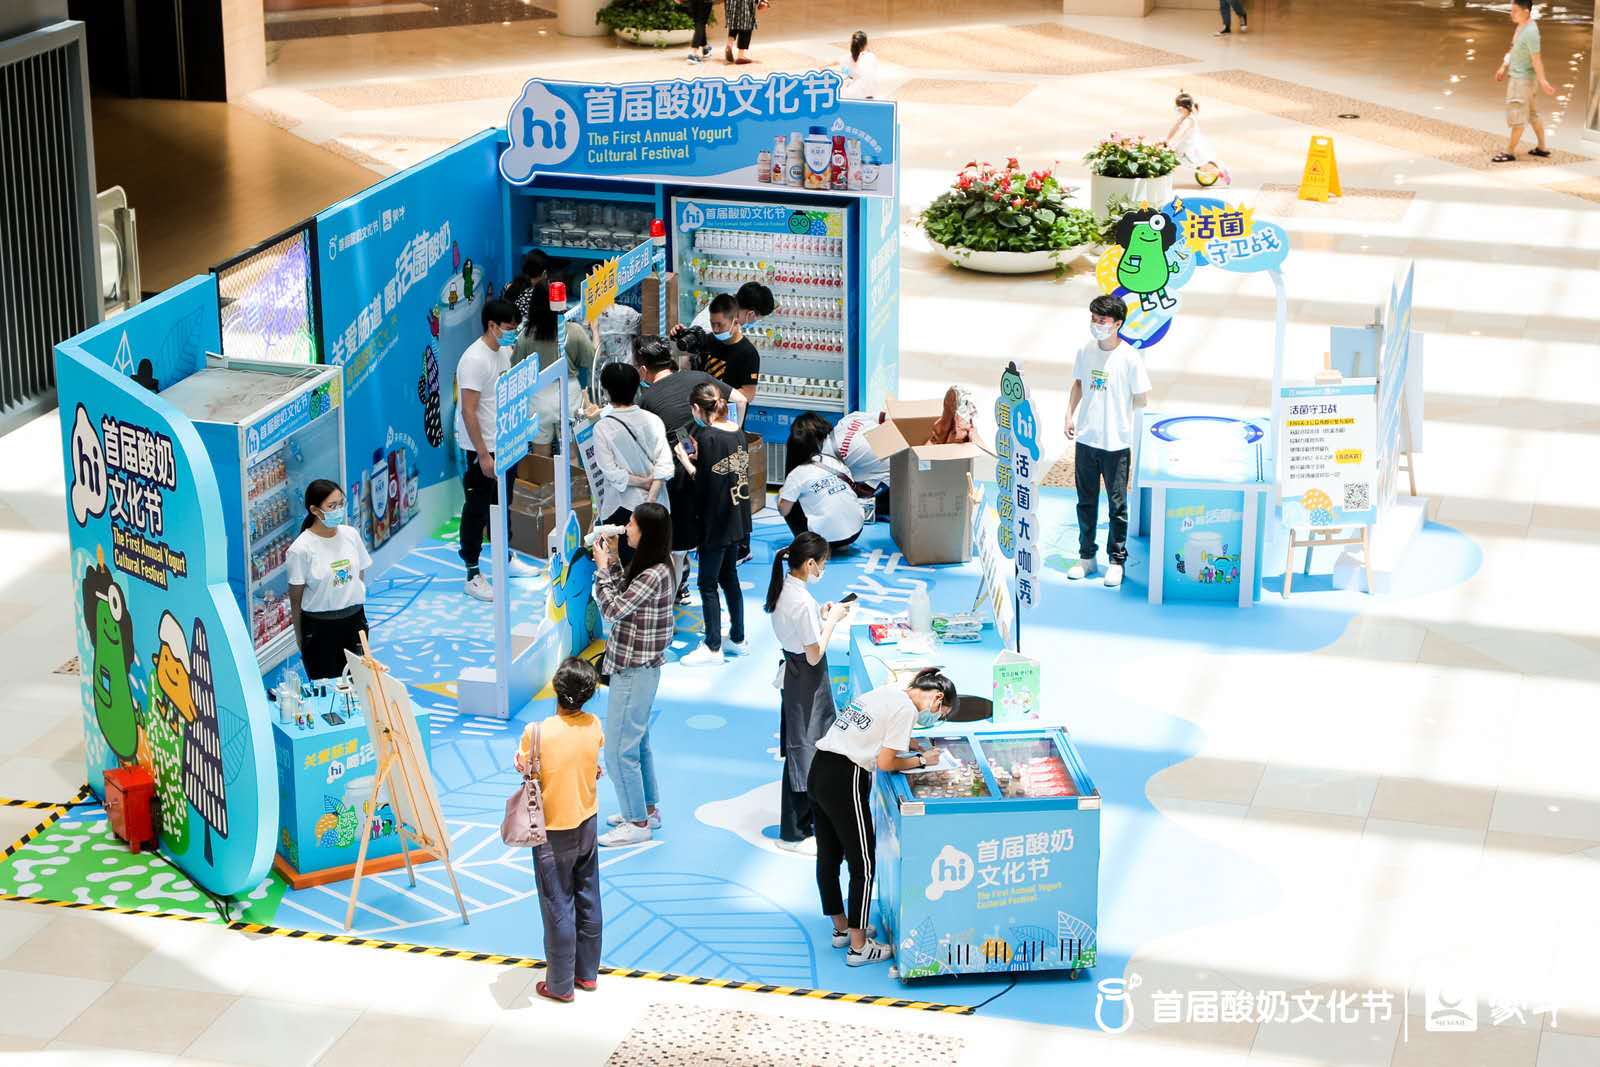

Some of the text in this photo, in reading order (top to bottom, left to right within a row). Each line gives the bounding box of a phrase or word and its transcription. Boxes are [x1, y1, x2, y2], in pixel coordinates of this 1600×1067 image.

[583, 73, 839, 124] 首届酸奶文化节
[522, 107, 566, 149] hi
[587, 126, 732, 146] The First Annual Yogurt
[588, 145, 690, 163] Cultural Festival
[685, 211, 700, 224] hi
[705, 207, 786, 220] 首届酸奶文化节
[1190, 212, 1243, 239] 活菌
[1208, 229, 1280, 263] 守卫战
[499, 359, 537, 408] 首届酸奶
[500, 396, 528, 434] 文化节
[1017, 411, 1033, 439] hi
[1290, 404, 1337, 415] 活菌守卫战
[77, 435, 101, 496] hi
[103, 419, 175, 487] 首届酸奶
[109, 474, 163, 533] 文化节
[1016, 453, 1031, 604] 活菌大咖秀
[113, 527, 186, 573] The First Annual Yogurt
[115, 549, 167, 586] Cultural Festival
[331, 766, 342, 775] hi
[977, 829, 1074, 863] 首届酸奶
[939, 856, 968, 882] hi
[977, 858, 1051, 888] 文化节
